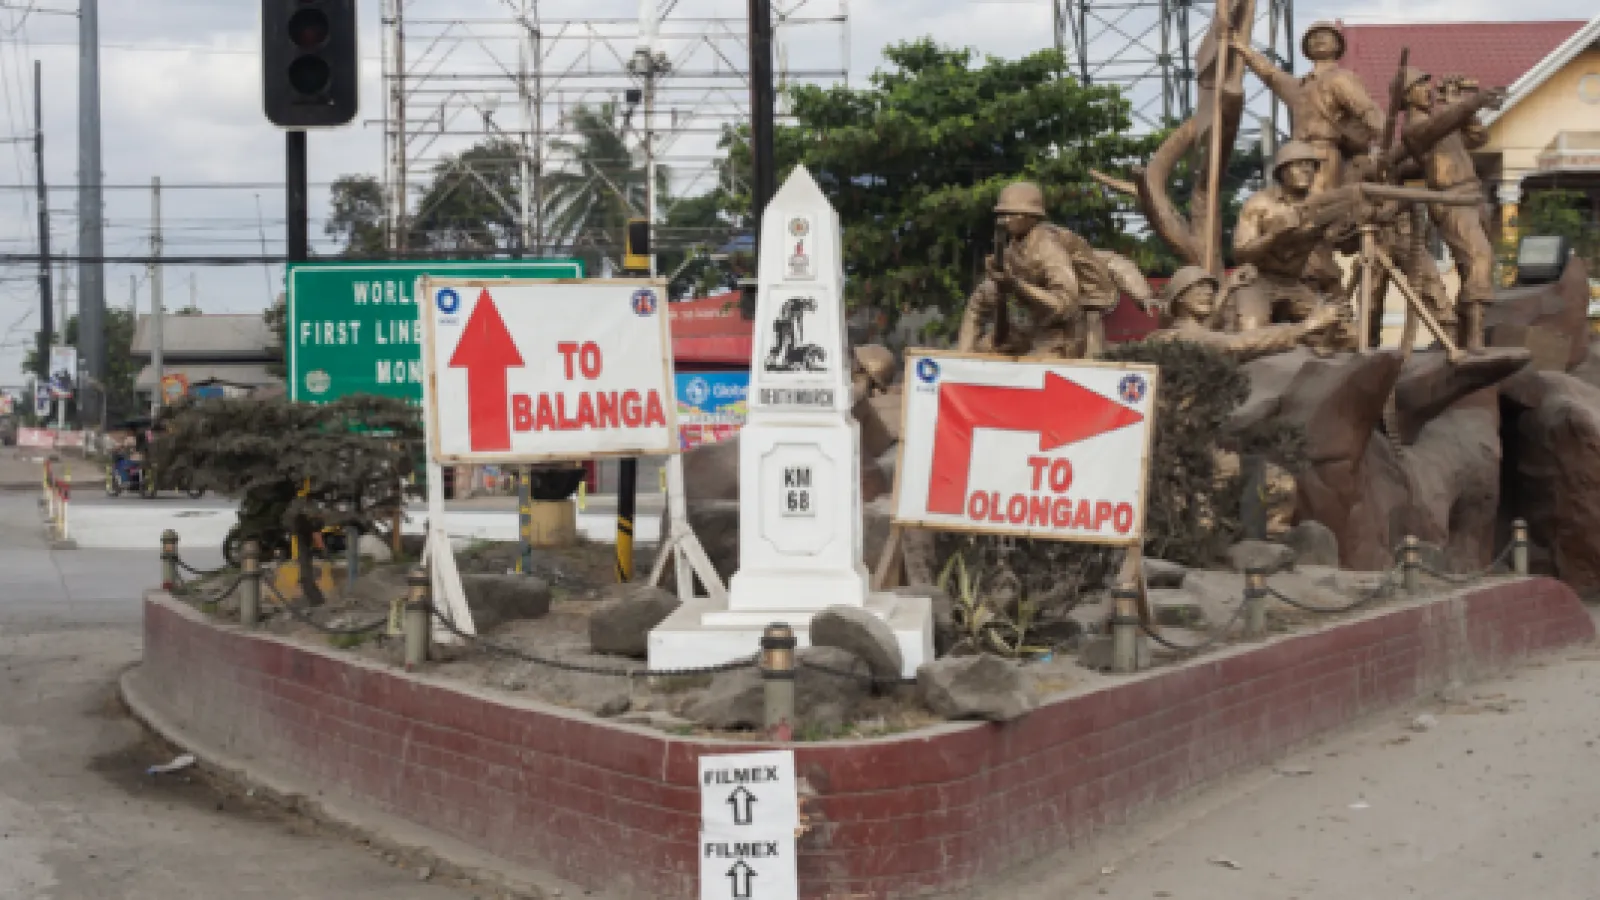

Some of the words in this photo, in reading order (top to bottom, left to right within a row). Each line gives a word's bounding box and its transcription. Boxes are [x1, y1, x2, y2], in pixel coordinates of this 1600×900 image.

[300, 320, 361, 345] FIRST
[375, 320, 421, 344] LINE
[557, 341, 603, 380] TO
[512, 389, 666, 432] BALANGA
[784, 466, 812, 488] KM
[1027, 455, 1075, 493] TO
[786, 490, 811, 512] 68
[968, 490, 1133, 533] OLONGAPO
[704, 766, 779, 785] FILMEX
[704, 841, 779, 858] FILMEX
